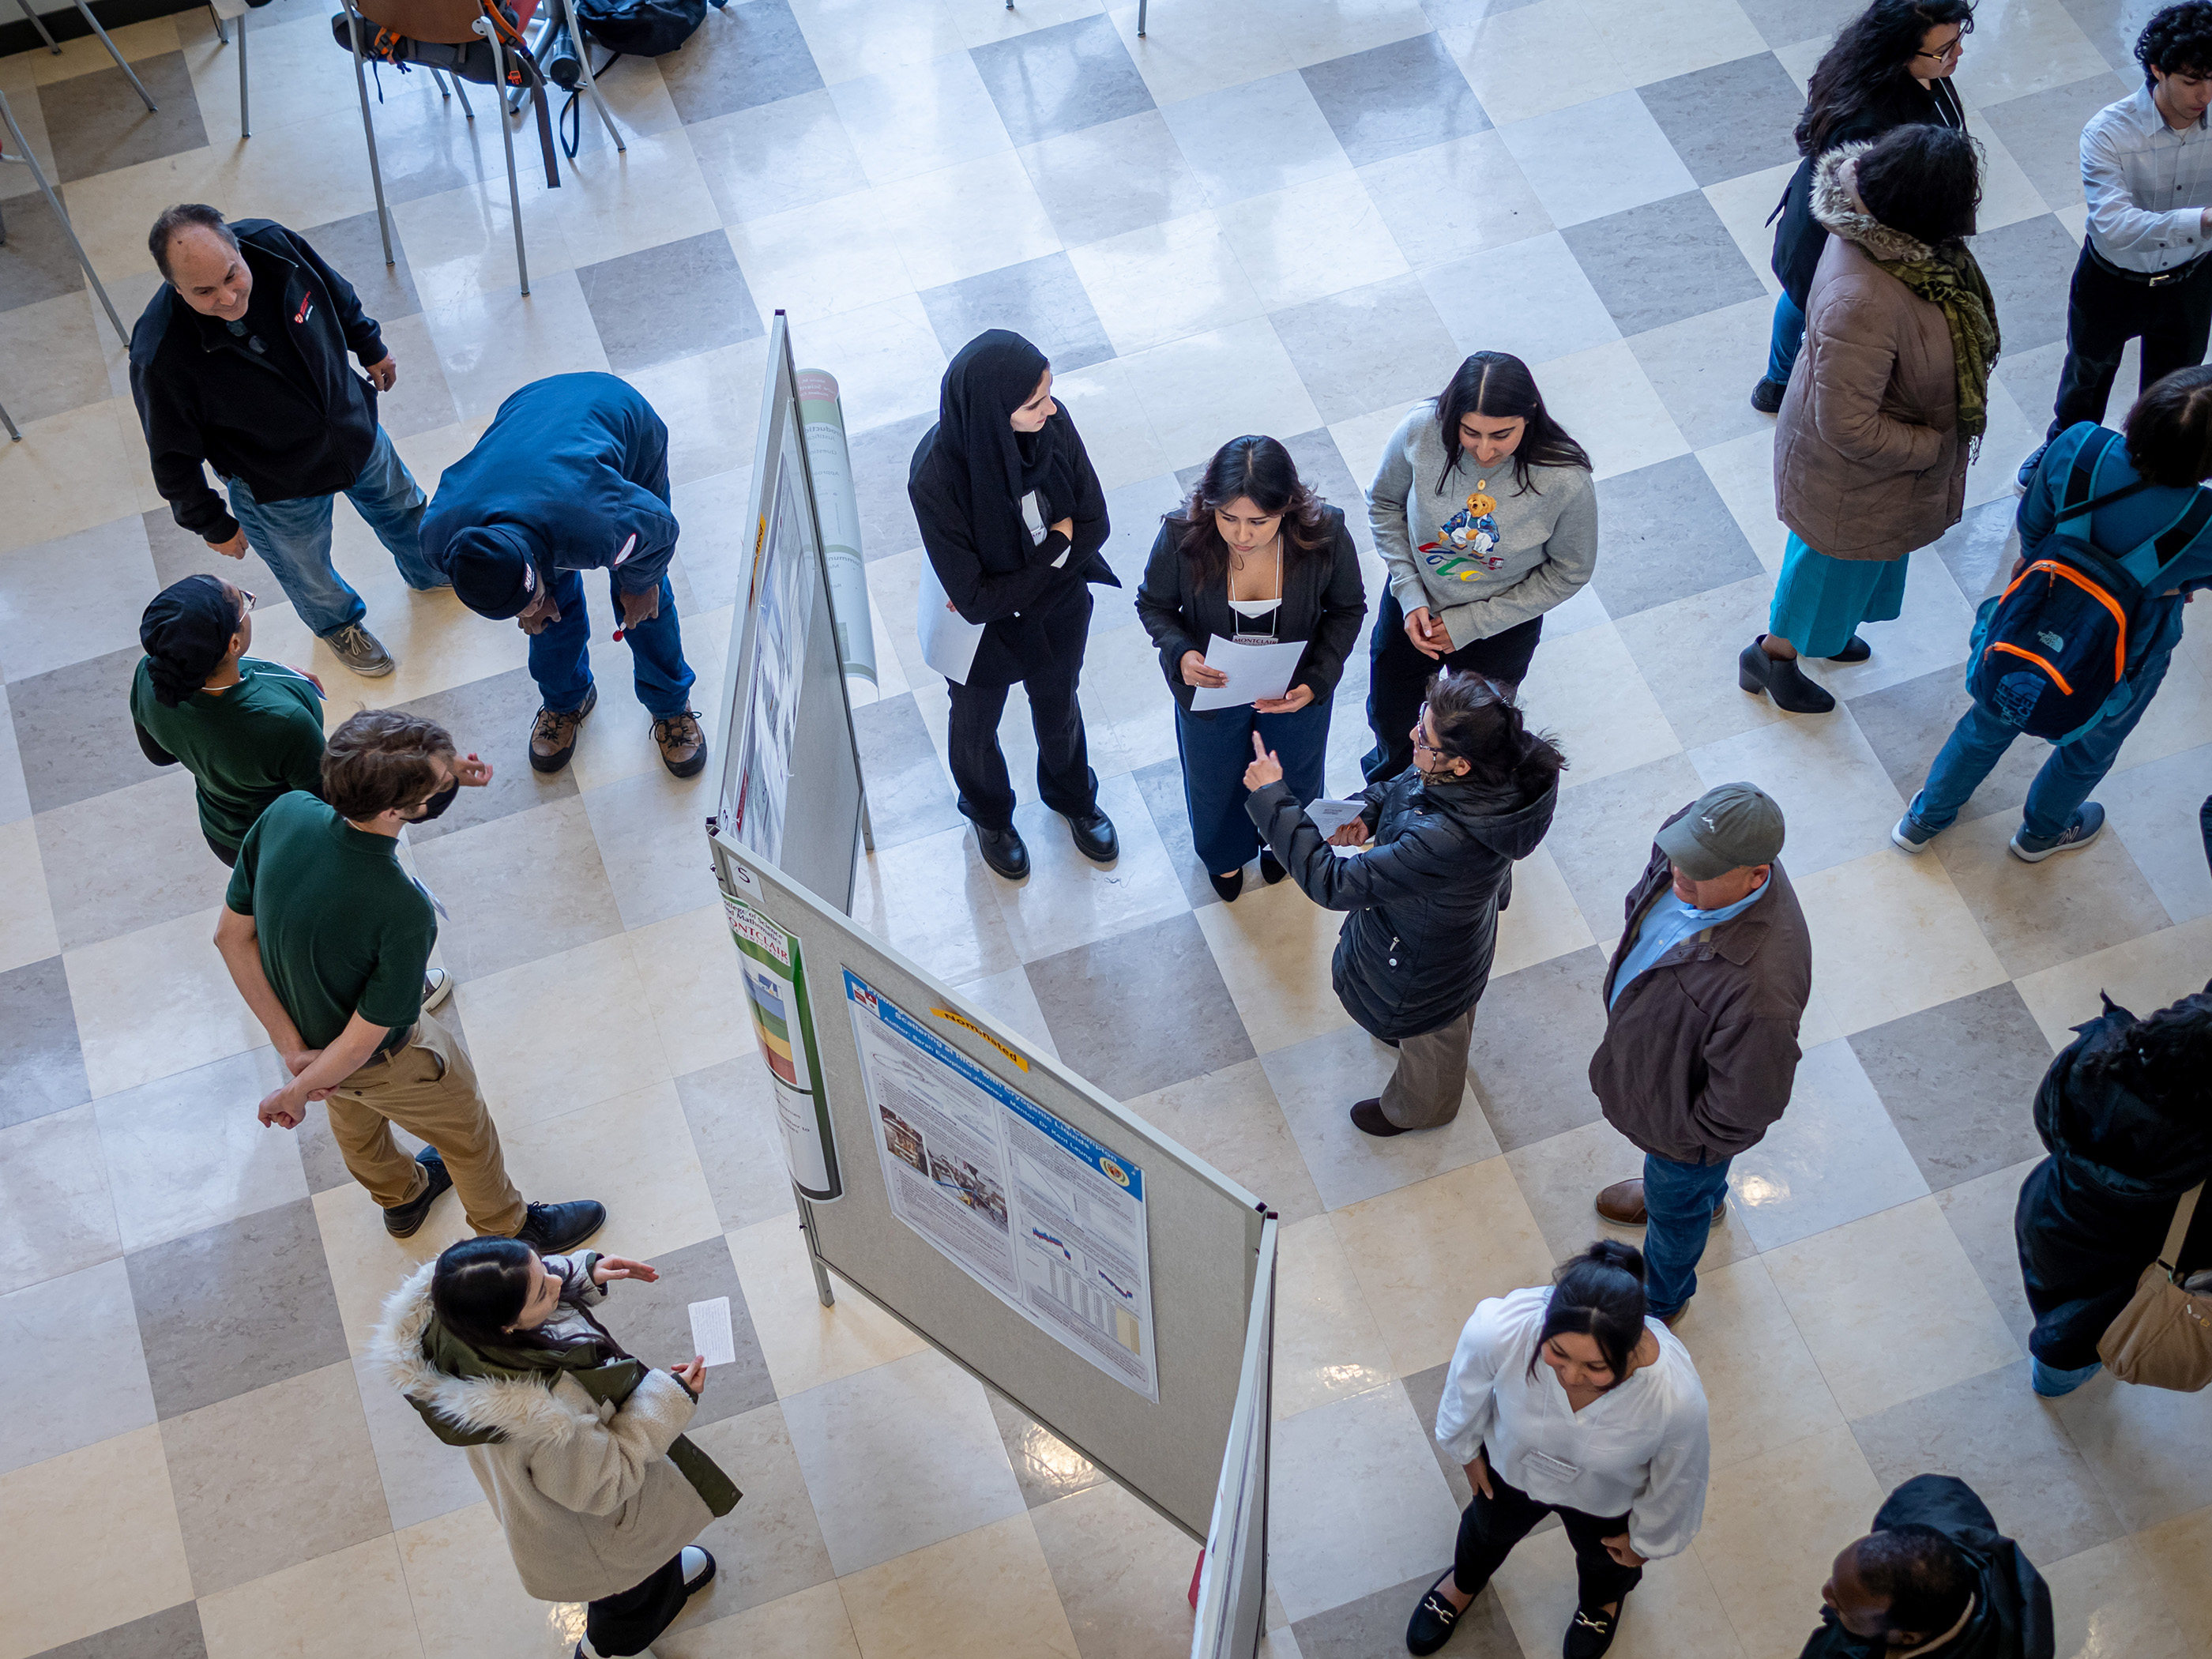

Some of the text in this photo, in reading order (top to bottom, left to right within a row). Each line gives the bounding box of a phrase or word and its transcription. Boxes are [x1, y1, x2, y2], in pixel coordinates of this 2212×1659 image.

[2013, 698, 2035, 728] FACE
[724, 900, 746, 916] ollege
[758, 917, 783, 939] Science
[728, 916, 788, 960] ONTCLAIR
[737, 913, 781, 945] Mathematics
[944, 1013, 1018, 1062] Nominated
[894, 1012, 942, 1048] Scattering
[944, 1046, 954, 1055] at
[982, 1072, 1002, 1088] with
[1004, 1086, 1052, 1123] Cryogenic
[1054, 1120, 1090, 1149] Liquids
[912, 1034, 934, 1051] Sarah
[1051, 1129, 1068, 1144] Kent
[1070, 1142, 1093, 1163] Leung
